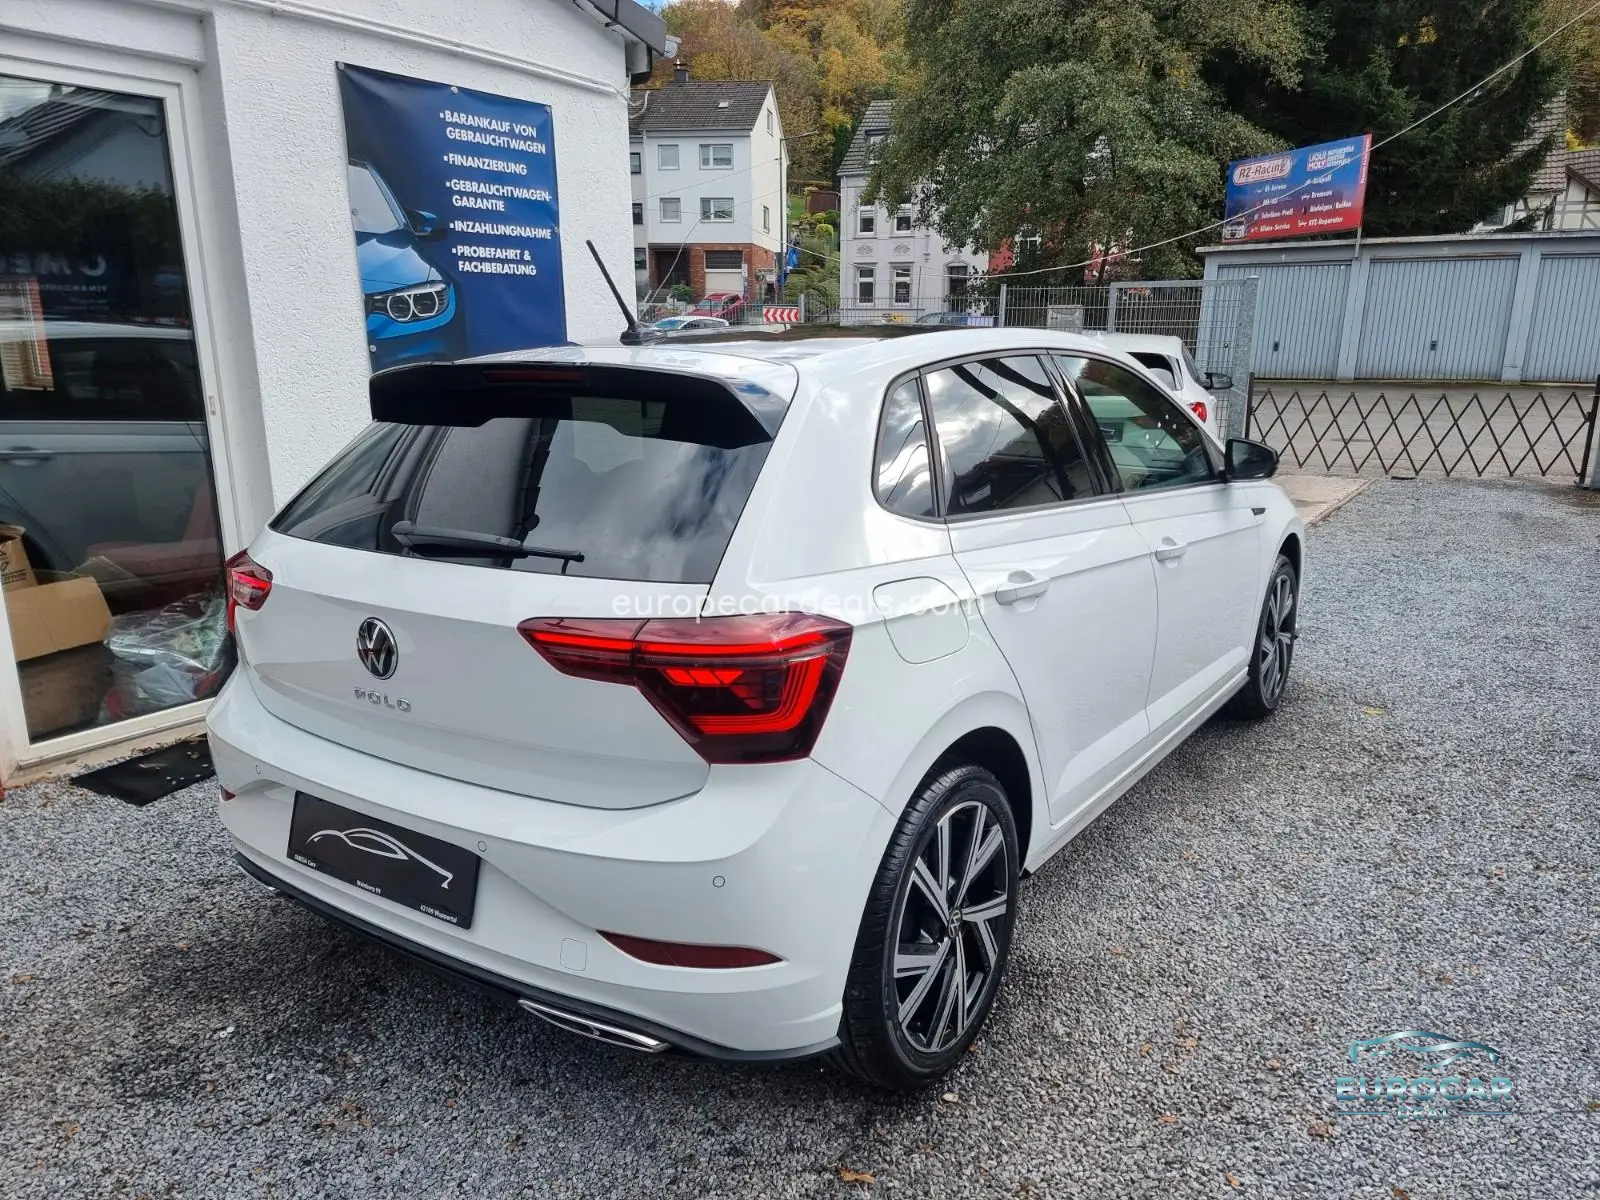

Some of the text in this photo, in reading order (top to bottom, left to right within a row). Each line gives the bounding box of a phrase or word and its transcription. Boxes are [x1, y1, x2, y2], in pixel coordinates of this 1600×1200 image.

[445, 110, 537, 138] BARANKAUF VON
[446, 127, 546, 154] GEBRAUCHTWAGEN
[449, 153, 527, 175] FINANZIERUNG
[451, 179, 552, 202] GEBRAUCHTWAGEN-
[453, 195, 505, 211] GARANTIE
[455, 220, 552, 239] INZAHLUNGNAHME
[457, 245, 532, 261] PROBEFAHRT &
[458, 260, 537, 276] FACHBERATUNG
[354, 687, 411, 712] POLO
